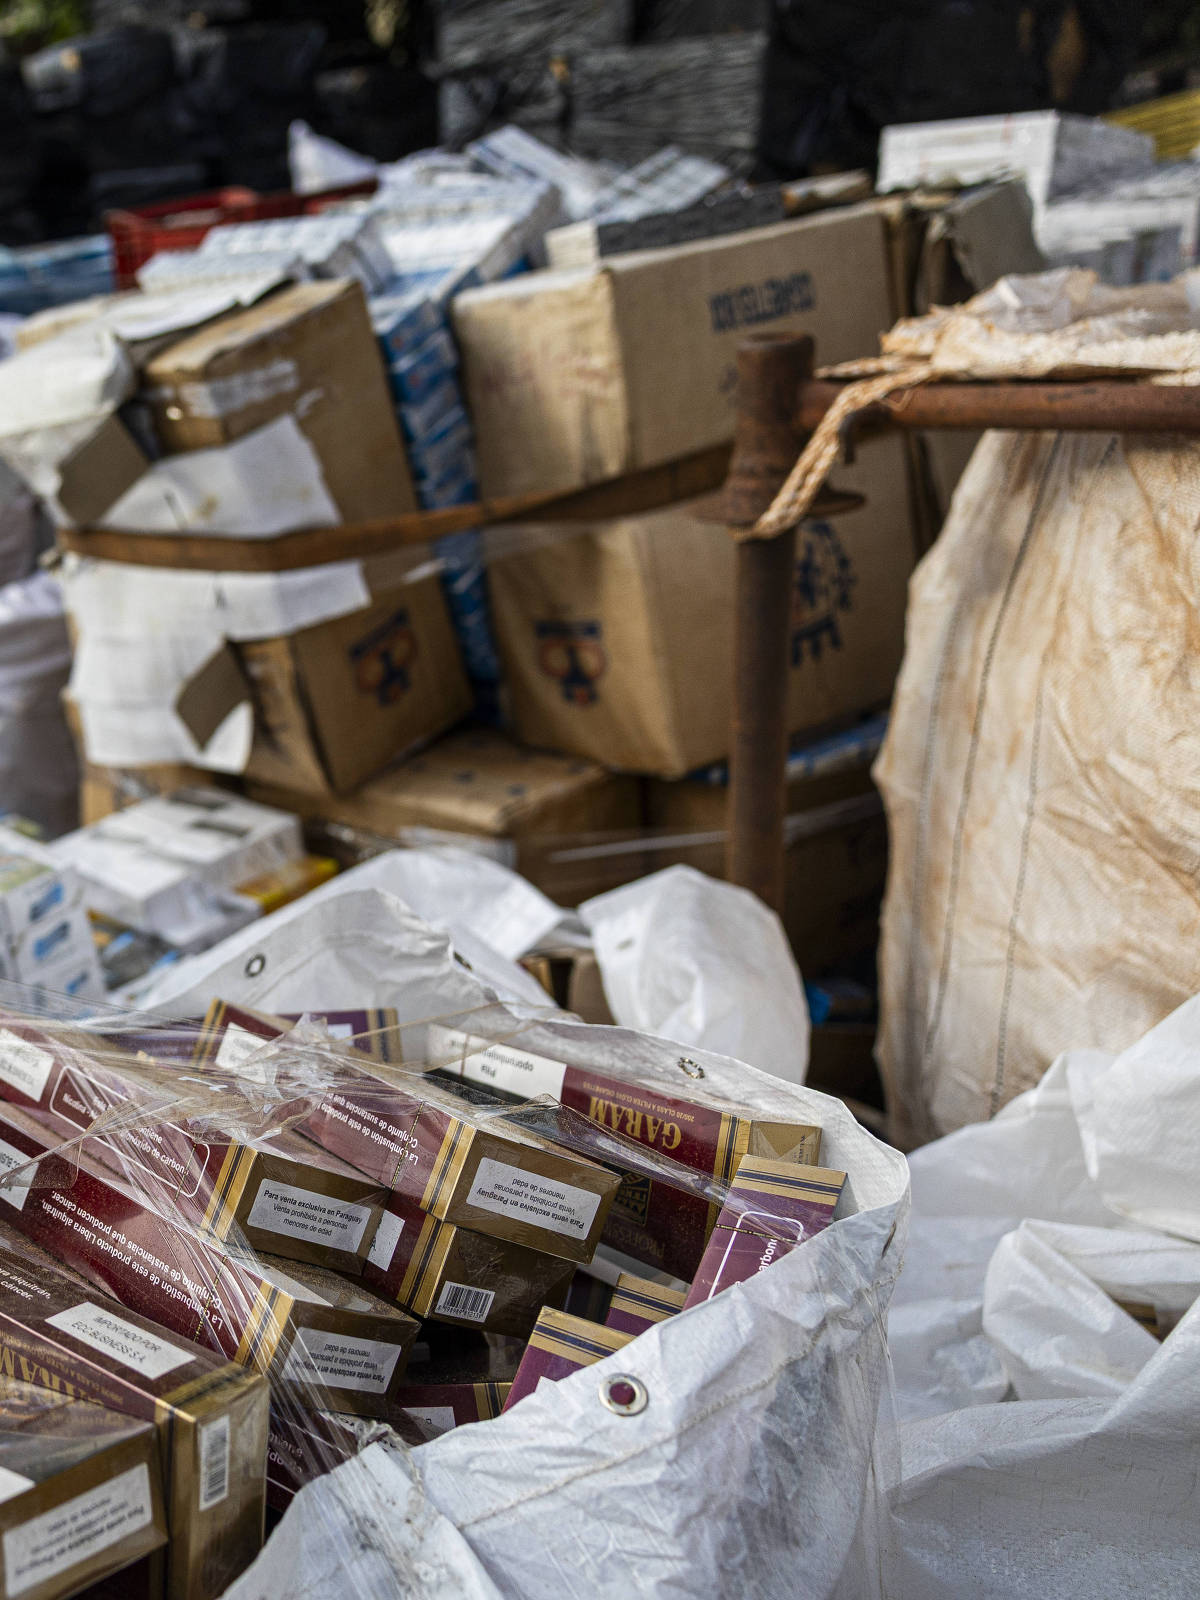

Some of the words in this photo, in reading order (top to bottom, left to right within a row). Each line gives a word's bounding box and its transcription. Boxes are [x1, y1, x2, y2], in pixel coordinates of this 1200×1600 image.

[346, 1117, 363, 1132] este
[376, 1119, 389, 1131] de
[586, 1097, 681, 1149] GARAM
[359, 1125, 371, 1137] de
[407, 1152, 419, 1166] La
[476, 1187, 508, 1205] Paraguay
[493, 1183, 523, 1197] personas
[538, 1187, 565, 1200] menores
[49, 1189, 78, 1213] cáncer.
[263, 1189, 278, 1200] Para
[297, 1201, 326, 1213] exclusiva
[335, 1209, 362, 1224] Paraguay
[529, 1195, 558, 1208] prohibida
[38, 1197, 75, 1228] alquitrán,
[272, 1203, 291, 1215] Venta
[290, 1209, 317, 1221] prohibida
[322, 1218, 348, 1230] personas
[519, 1202, 550, 1216] exclusiva
[558, 1204, 575, 1215] Venta
[76, 1207, 112, 1234] producen
[283, 1218, 308, 1230] menores
[550, 1212, 569, 1223] venta
[569, 1218, 584, 1229] Para
[73, 1222, 96, 1244] Libera
[109, 1228, 128, 1245] que
[96, 1238, 131, 1265] producto
[127, 1241, 169, 1272] sustancias
[130, 1260, 150, 1278] este
[168, 1268, 182, 1282] de
[147, 1272, 161, 1287] de
[208, 1314, 223, 1330] La
